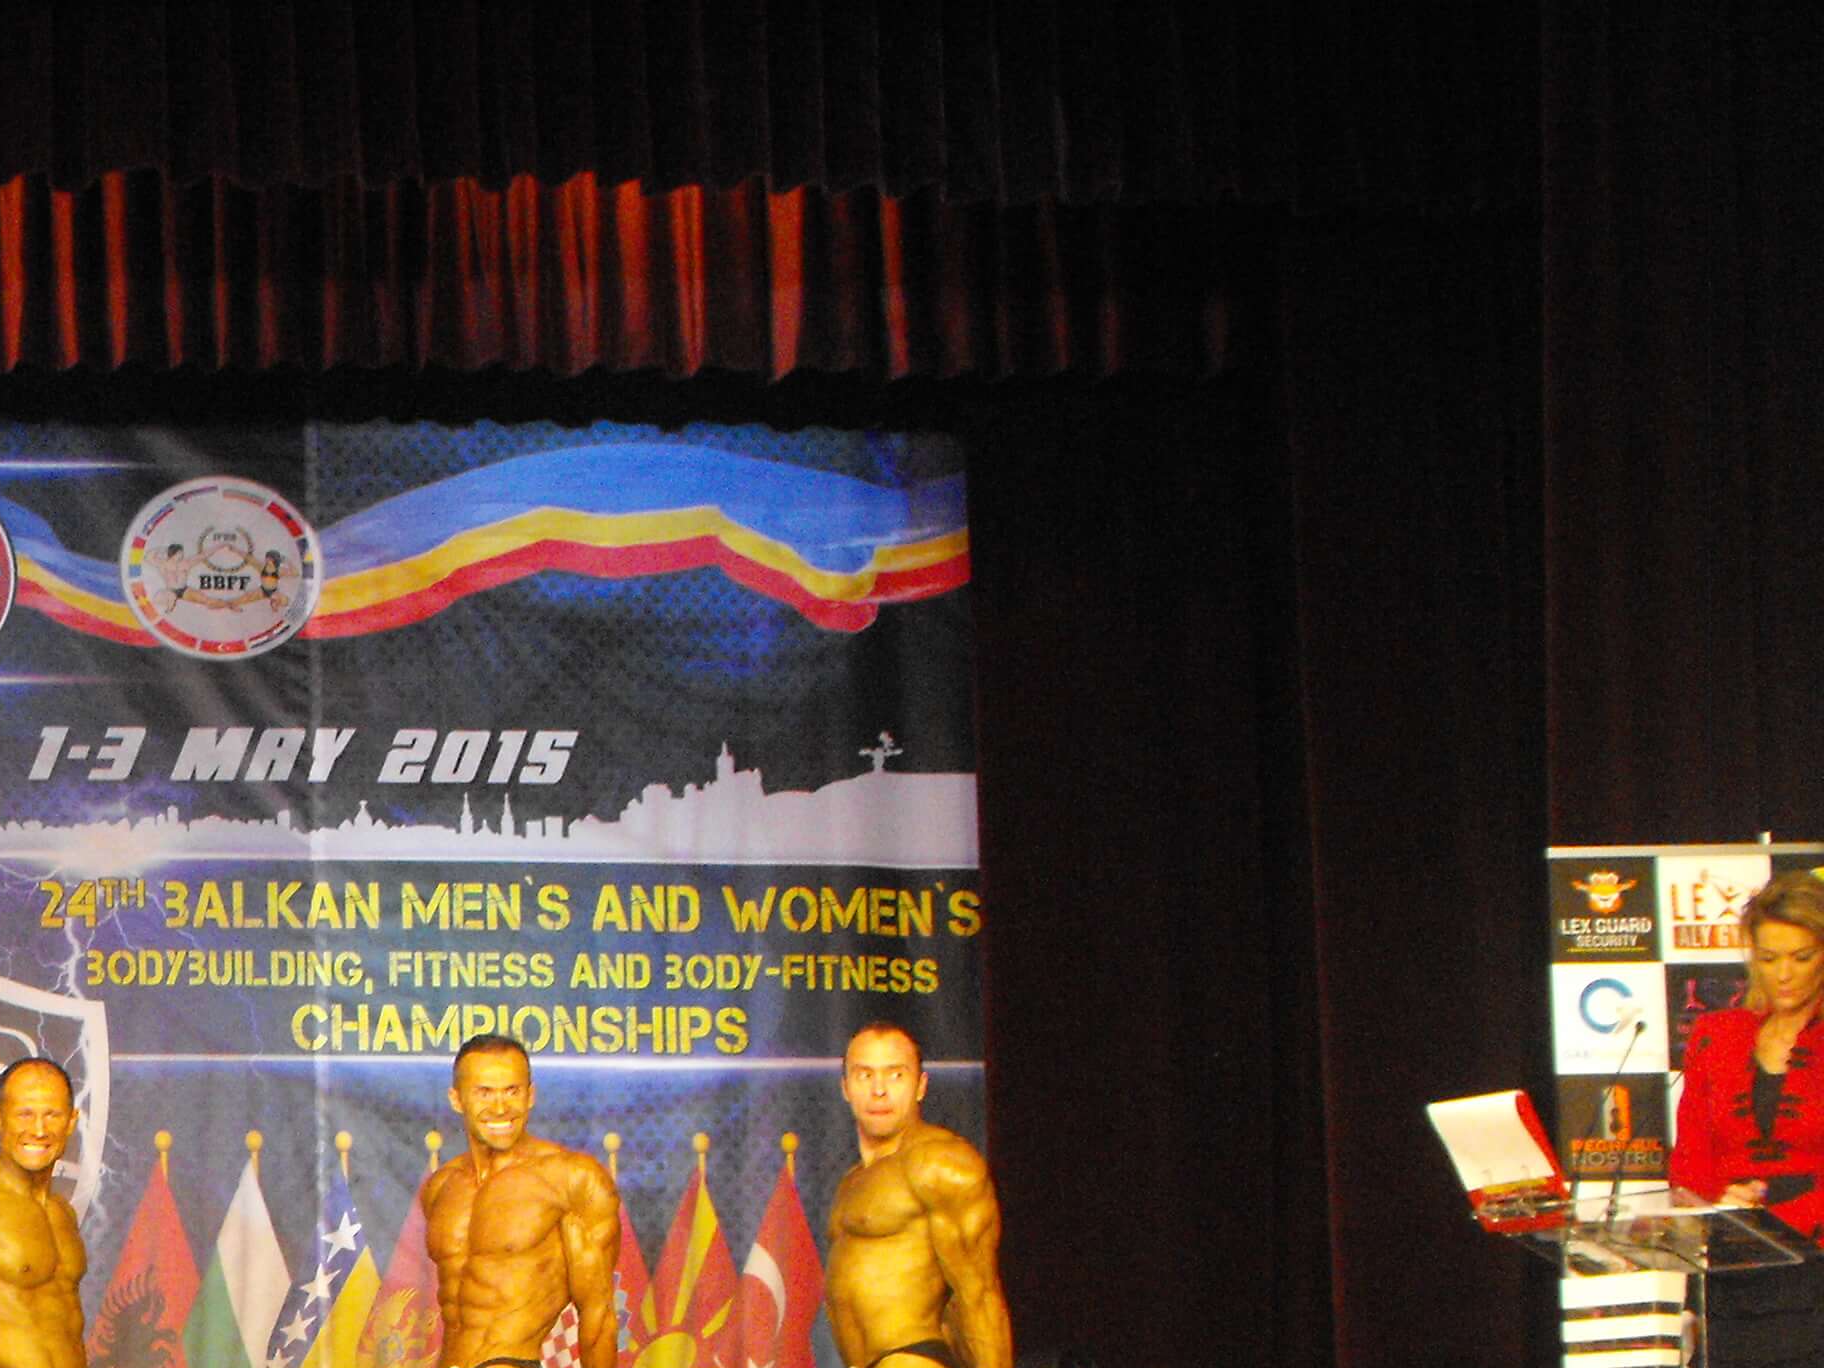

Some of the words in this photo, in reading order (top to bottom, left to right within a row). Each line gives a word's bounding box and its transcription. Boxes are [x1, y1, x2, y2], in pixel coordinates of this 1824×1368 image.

[199, 575, 251, 591] BBFF
[27, 725, 148, 782] 1-3
[169, 726, 357, 783] MAY
[376, 728, 579, 785] 2015
[38, 878, 146, 931] 24TH
[162, 879, 381, 931] BALKAN
[592, 883, 701, 933] AND
[1560, 918, 1592, 936] LEX
[1594, 916, 1653, 934] GUARD
[1575, 933, 1639, 948] SECURITY
[86, 949, 374, 995] BODYBUILDING,
[388, 950, 555, 988] FITNESS
[569, 951, 652, 990] AND
[664, 952, 940, 994] BODY-FITNESS
[290, 1003, 751, 1054] CHAMPIONSHIPS
